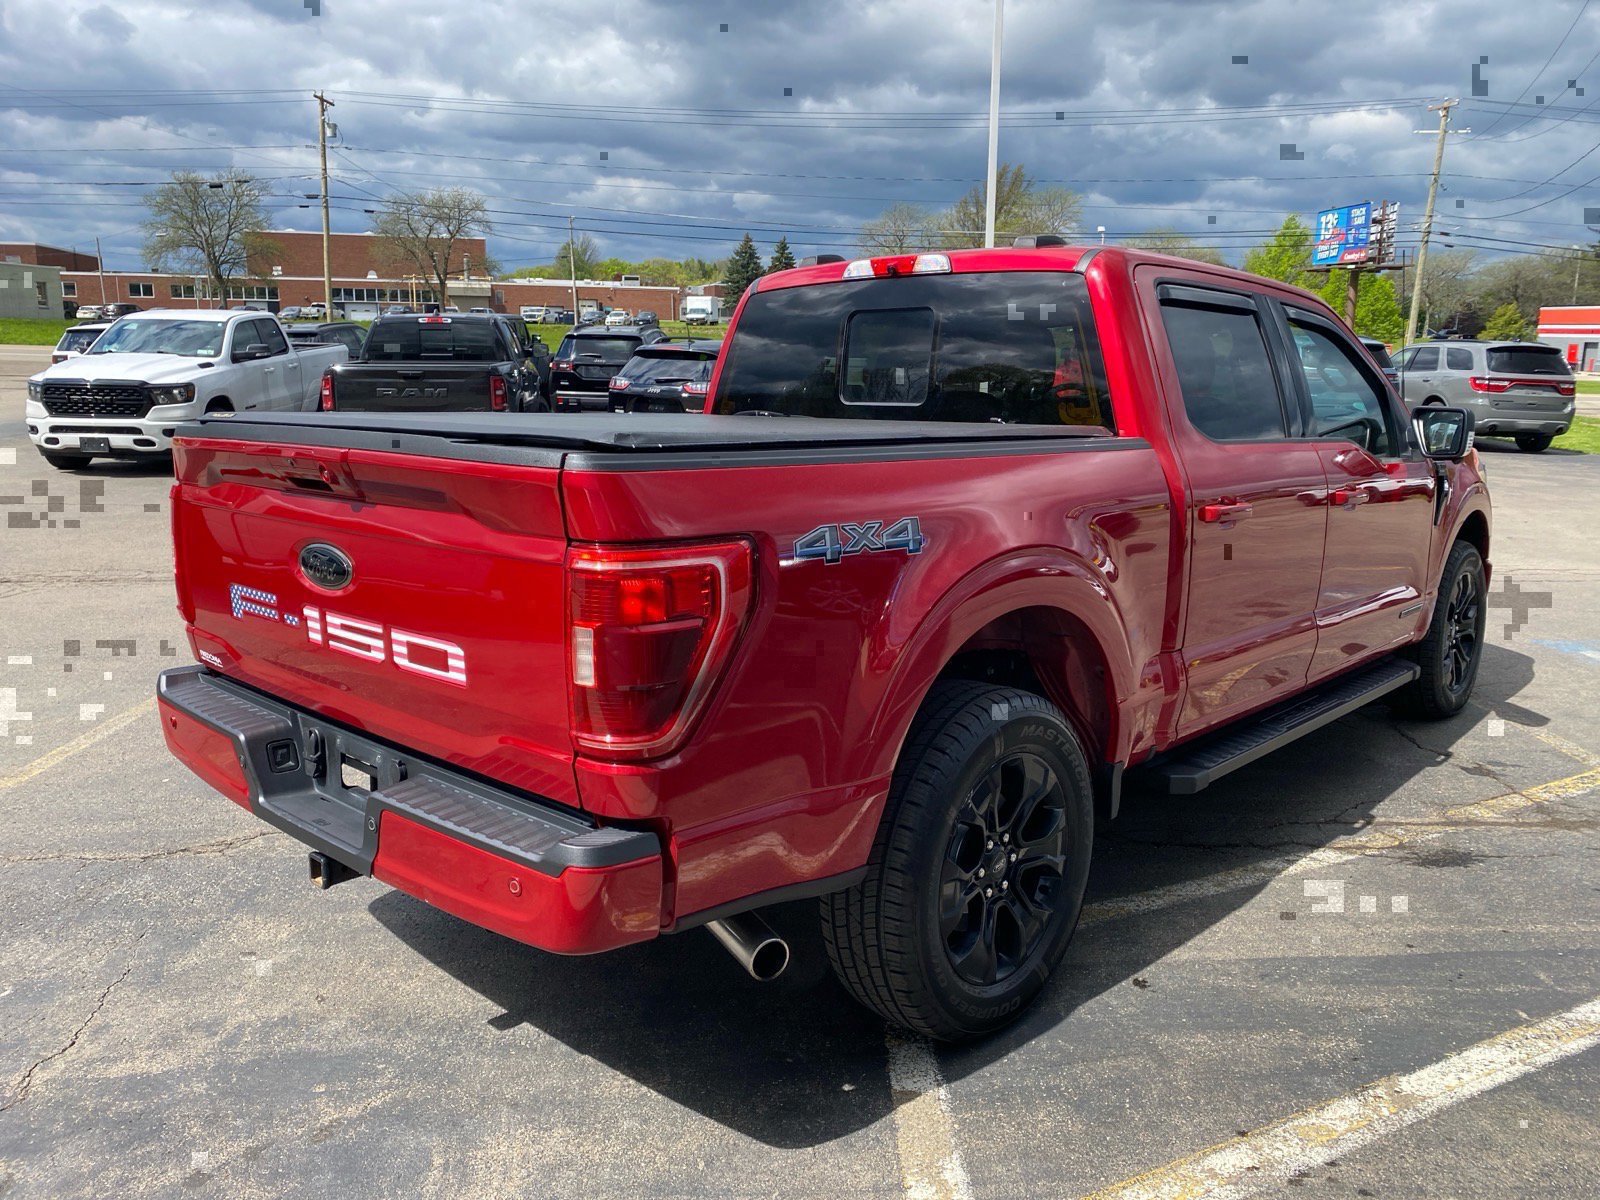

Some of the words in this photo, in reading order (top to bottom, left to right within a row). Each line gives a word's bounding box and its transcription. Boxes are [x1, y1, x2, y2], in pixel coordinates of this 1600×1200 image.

[376, 388, 448, 399] RAM
[308, 552, 337, 580] Ford
[229, 583, 467, 688] F-150
